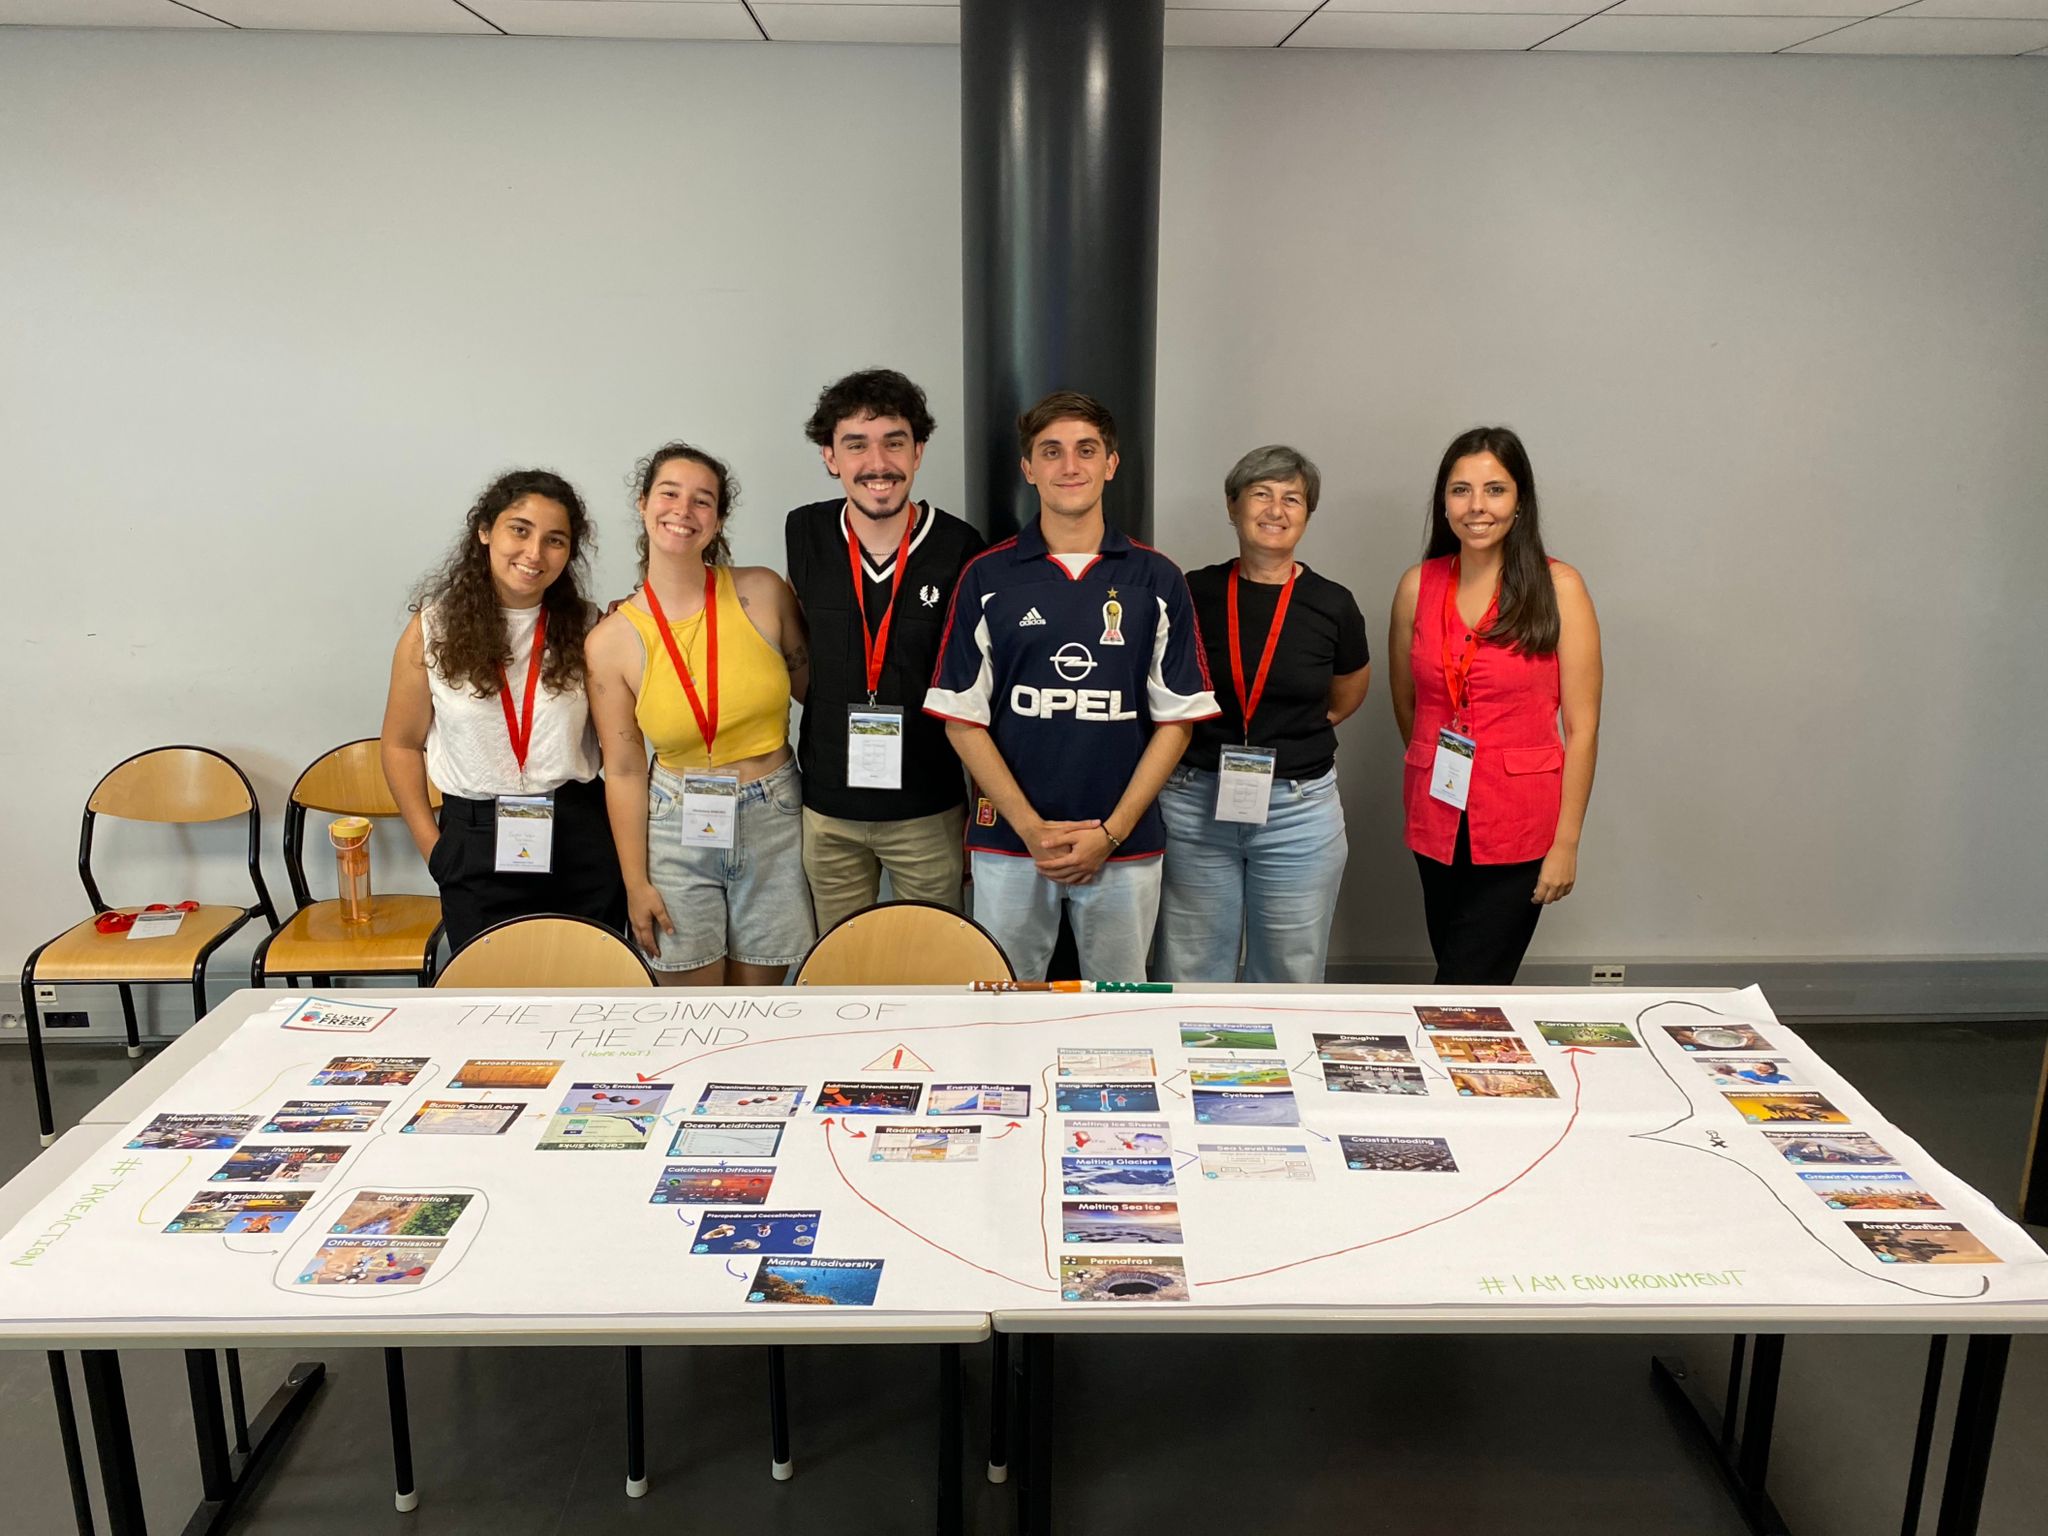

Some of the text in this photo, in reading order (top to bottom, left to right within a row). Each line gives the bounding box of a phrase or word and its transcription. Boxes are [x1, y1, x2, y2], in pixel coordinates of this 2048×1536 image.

[1019, 617, 1047, 627] adidas
[1010, 684, 1137, 722] OPEL
[325, 1012, 374, 1023] CLIMATE
[456, 1003, 553, 1026] THE
[835, 1002, 907, 1022] OF
[318, 1017, 369, 1027] FRESK
[539, 1027, 750, 1051] THE END
[1060, 1048, 1086, 1056] Rising
[346, 1056, 413, 1066] Building Usage
[1365, 1065, 1404, 1073] Flooding
[1485, 1068, 1511, 1076] Crop
[1222, 1092, 1264, 1100] Cyclones
[1770, 1092, 1820, 1100] Biodiversity
[429, 1102, 464, 1111] Burning
[167, 1114, 251, 1123] Human activities
[1072, 1120, 1108, 1128] Melting
[934, 1127, 970, 1135] Forcing
[1767, 1131, 1808, 1139] Population
[1351, 1136, 1435, 1146] Coastal Flooding
[272, 1146, 313, 1154] Industry
[1076, 1158, 1158, 1167] Melting Glaciers
[1805, 1173, 1904, 1183] Growing Inequality
[223, 1192, 283, 1201] Agriculture
[378, 1194, 449, 1203] Deforestation
[1078, 1203, 1119, 1212] Melting
[1121, 1203, 1142, 1211] Sea
[1862, 1223, 1952, 1231] Armed Conflicts
[329, 1239, 441, 1248] Other GHG Emissions
[767, 1258, 878, 1269] Marine Biodiversity
[1090, 1257, 1153, 1266] Permafrost
[1477, 1269, 1746, 1295] # I AM ENVIRONMENT
